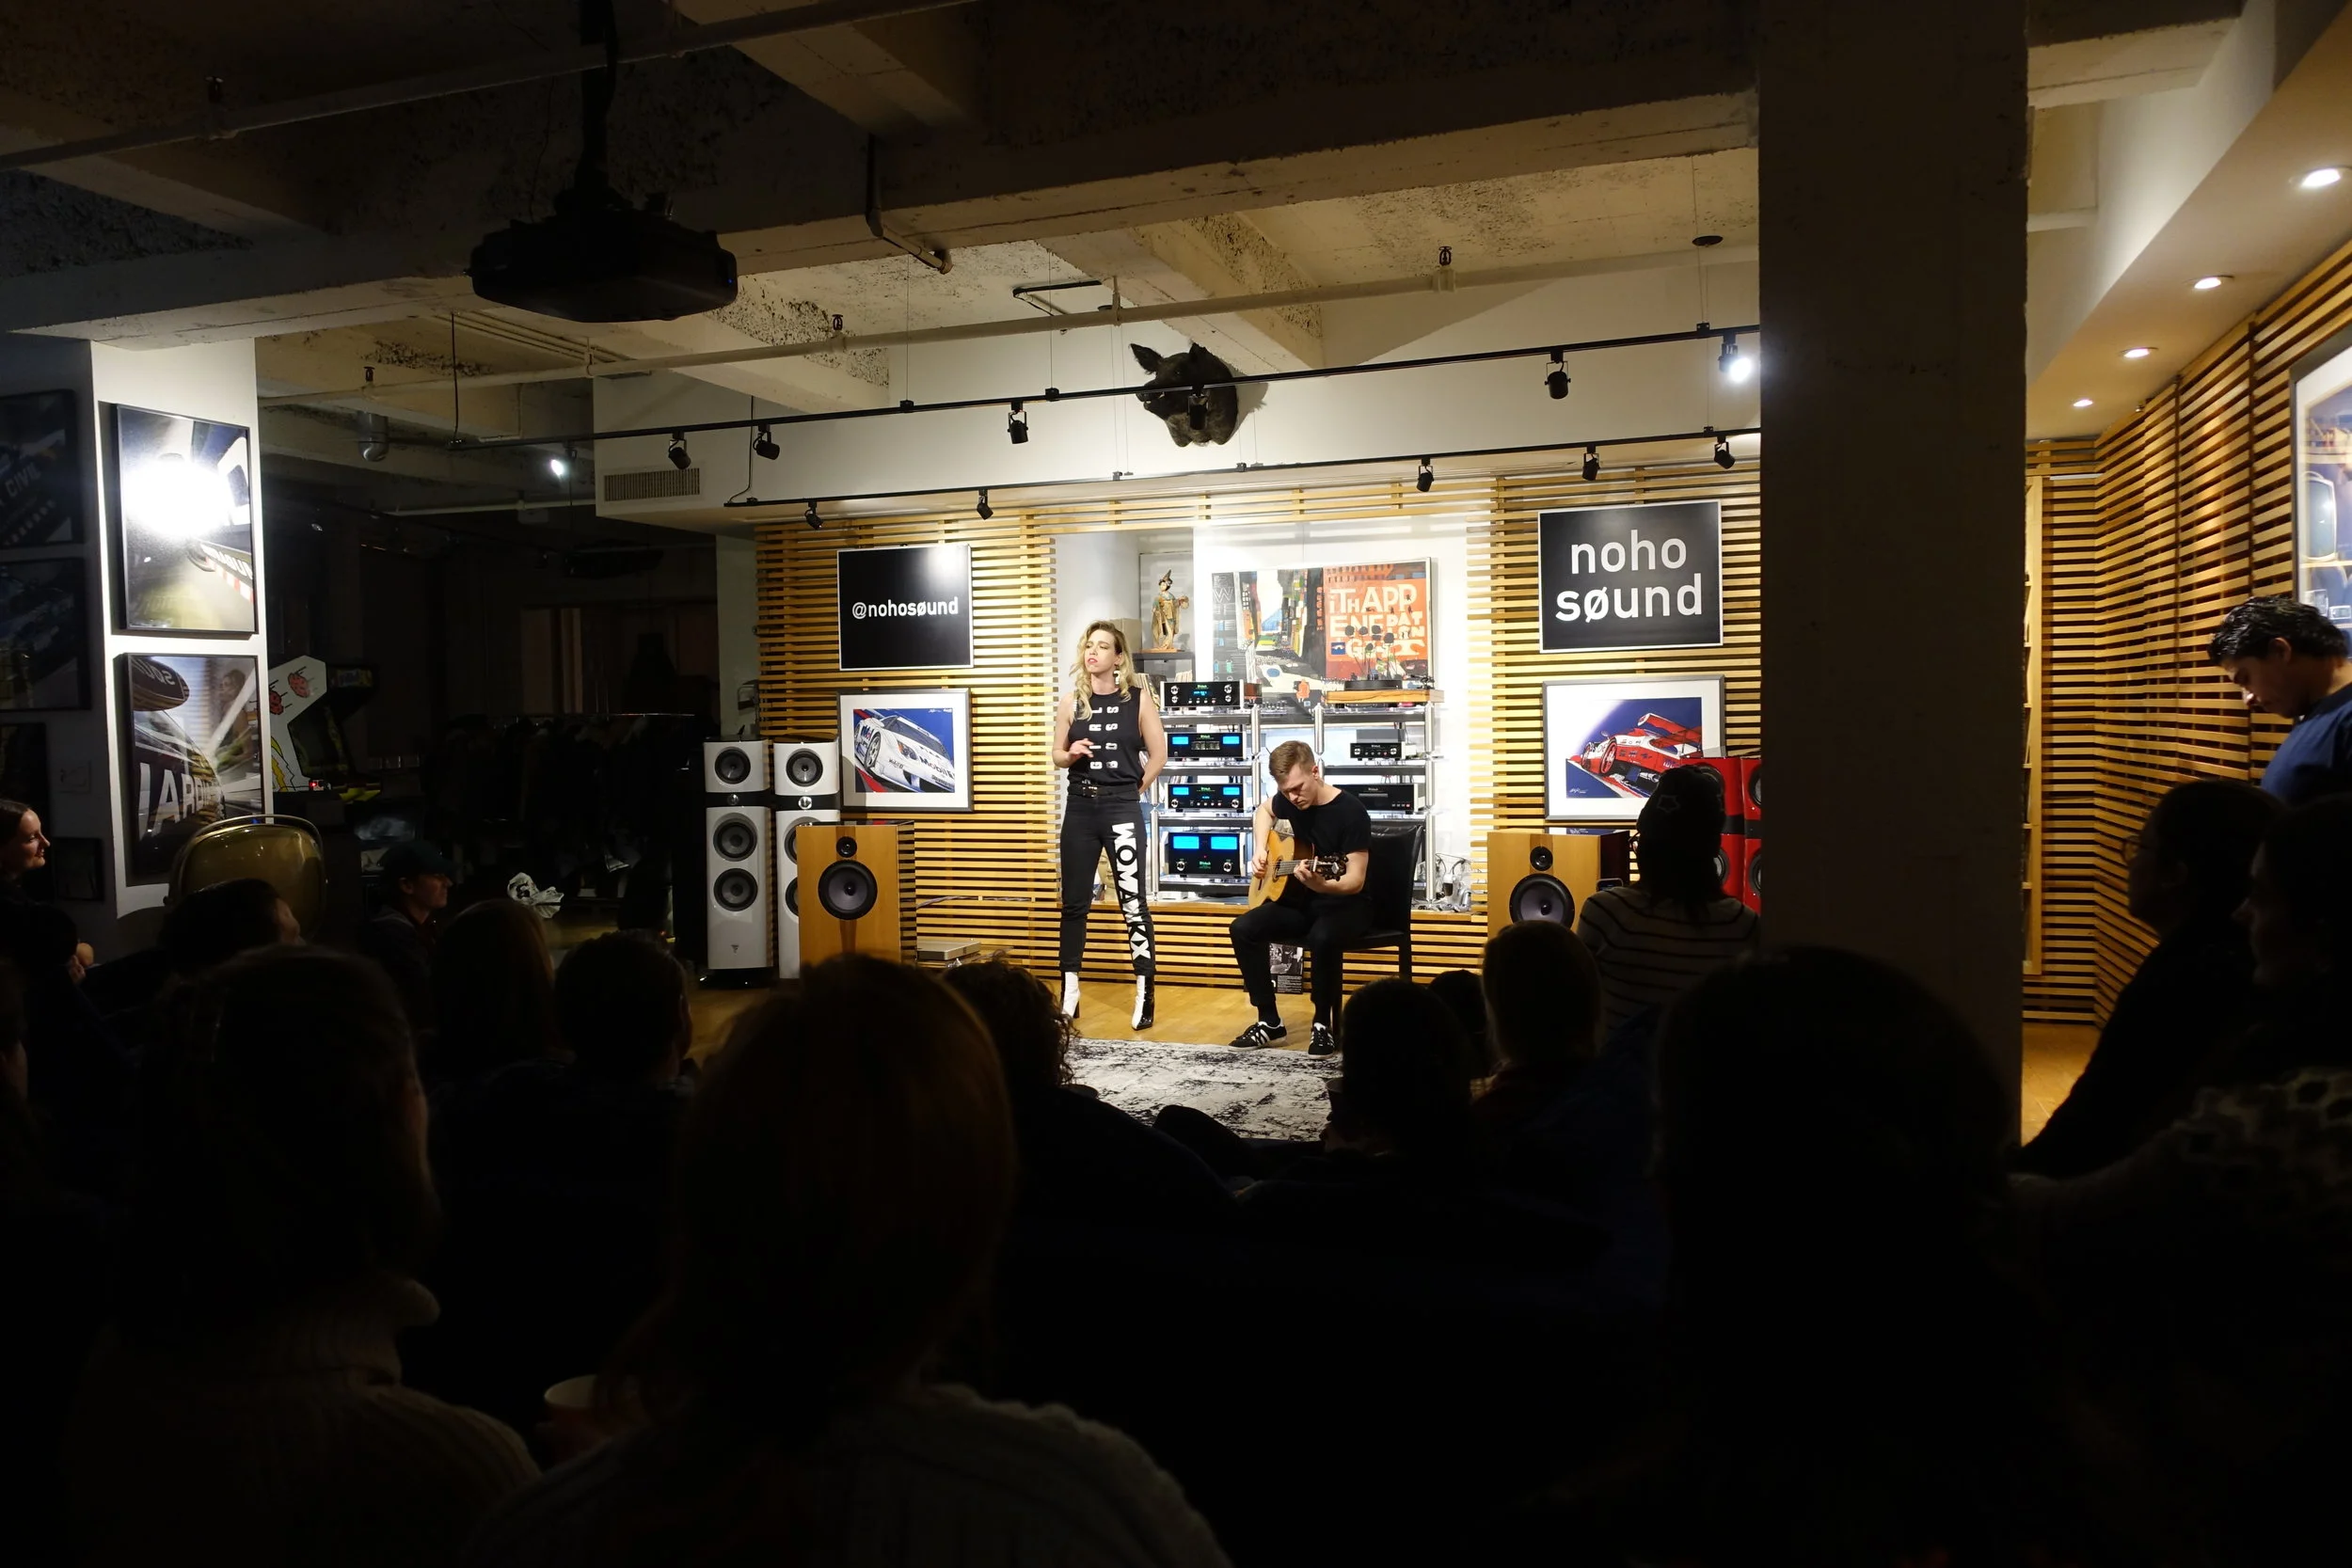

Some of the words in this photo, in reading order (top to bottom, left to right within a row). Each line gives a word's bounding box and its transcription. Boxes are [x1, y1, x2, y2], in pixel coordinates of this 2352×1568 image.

[1571, 529, 1687, 575] noho
[851, 595, 959, 620] @nohosøund
[1555, 572, 1702, 624] søund
